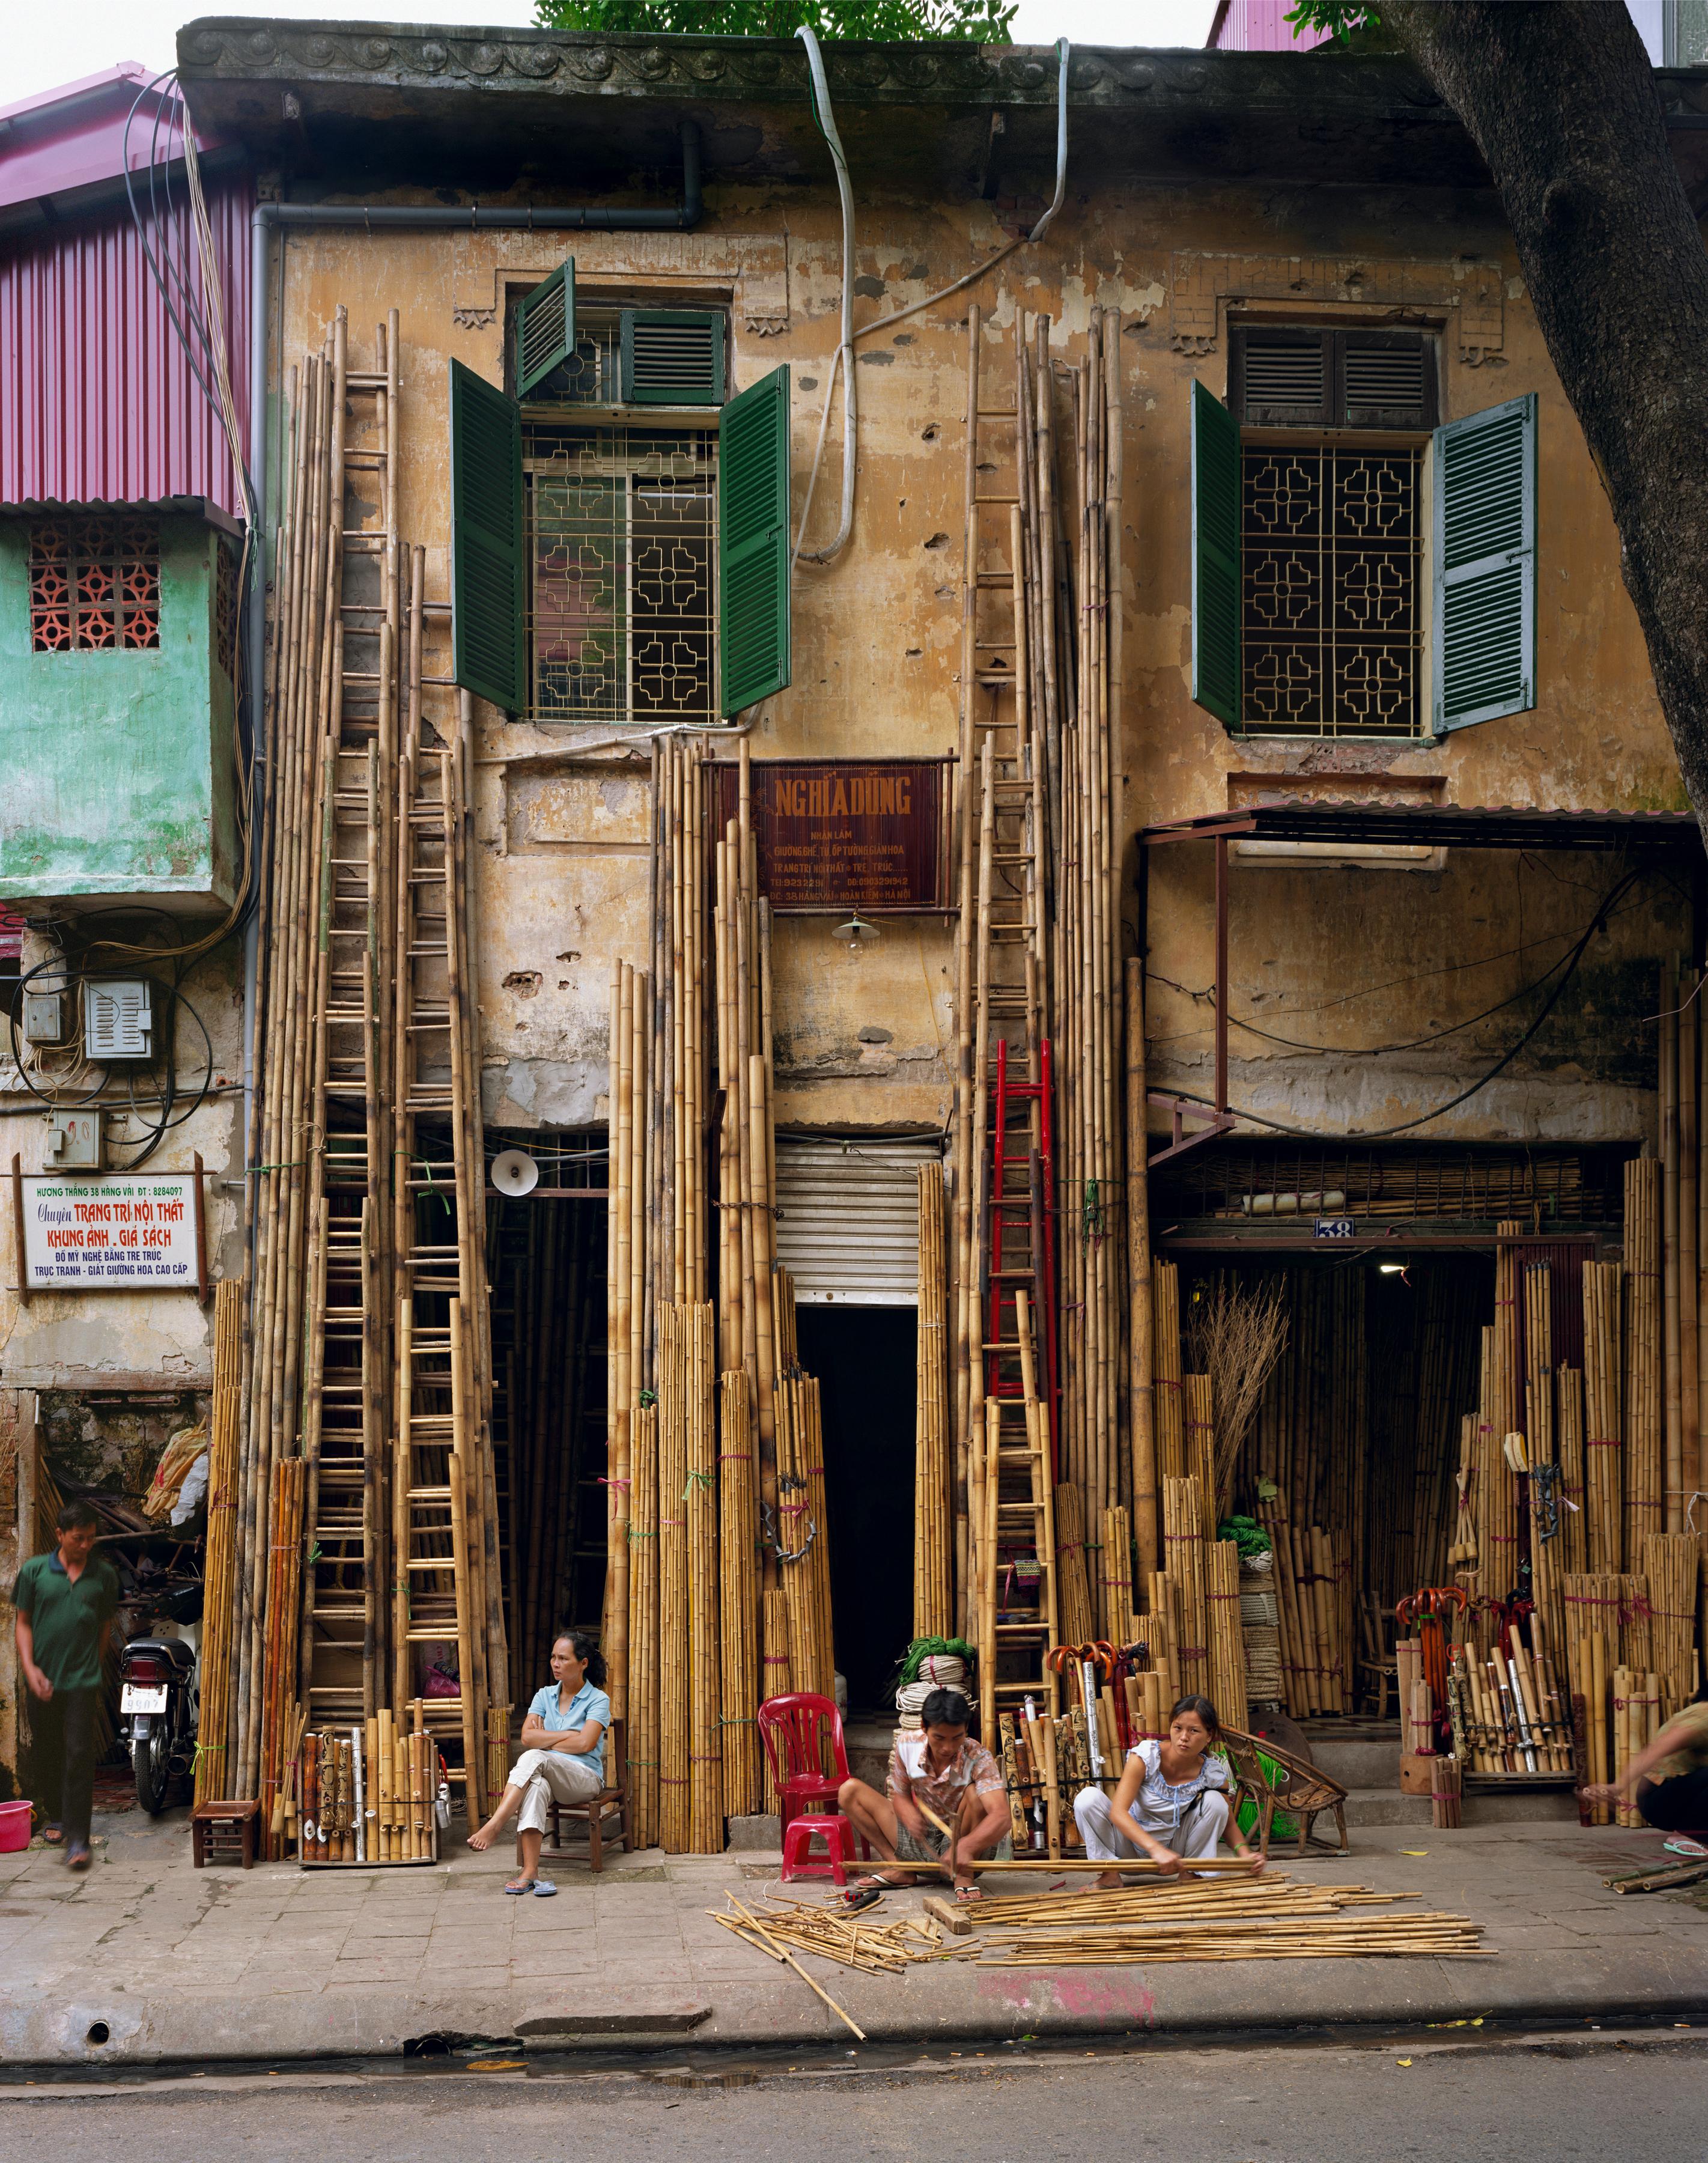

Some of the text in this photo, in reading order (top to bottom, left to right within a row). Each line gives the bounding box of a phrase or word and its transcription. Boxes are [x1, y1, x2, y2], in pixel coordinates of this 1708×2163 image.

[37, 1187, 63, 1197] HƯƠNG
[65, 1182, 88, 1197] THẮNG
[91, 1187, 99, 1196] 38
[101, 1184, 121, 1196] HÀNG
[123, 1182, 134, 1196] VẢI
[138, 1187, 147, 1196] ĐT
[153, 1187, 183, 1196] 8284097
[38, 1198, 184, 1226] Chuyên TRANG TRÍ NỘI THẤT
[47, 1229, 84, 1249] KHUNG
[87, 1224, 109, 1248] ẢNH
[119, 1225, 138, 1247] GIÁ
[143, 1225, 172, 1249] SÁCH
[1319, 1221, 1351, 1238] 38
[68, 1249, 79, 1262] MỸ
[82, 1249, 102, 1264] NGHỆ
[105, 1247, 125, 1261] BẰNG
[127, 1251, 141, 1261] TRE
[142, 1249, 162, 1261] TRÚC
[35, 1266, 54, 1278] TRỤC
[56, 1266, 81, 1276] TRANH
[107, 1264, 135, 1276] GIƯỜNG
[138, 1264, 153, 1275] HOA
[156, 1265, 171, 1274] CAO
[173, 1262, 188, 1274] CẤP
